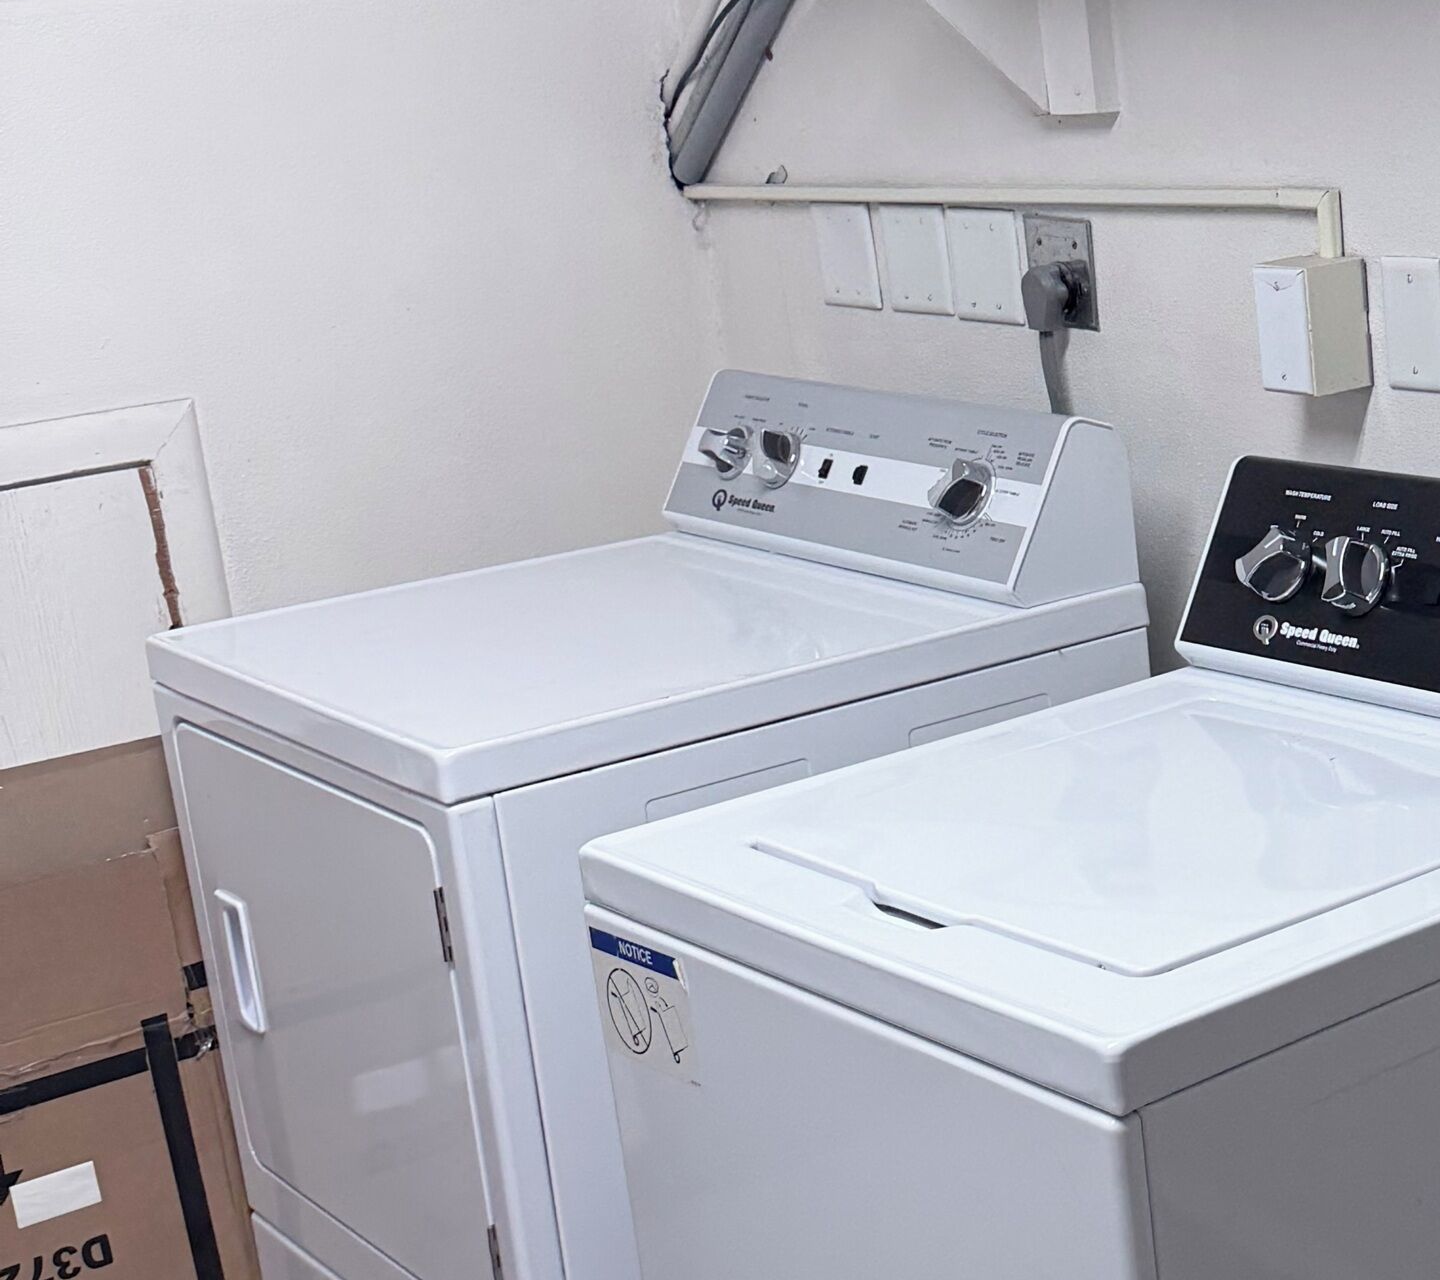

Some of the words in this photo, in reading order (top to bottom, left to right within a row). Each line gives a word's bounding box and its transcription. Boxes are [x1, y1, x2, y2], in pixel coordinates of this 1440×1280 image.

[728, 495, 752, 508] Speed
[752, 499, 775, 512] Queen
[1280, 621, 1318, 640] Speed
[1319, 629, 1358, 649] Queen
[617, 940, 653, 965] NOTICE
